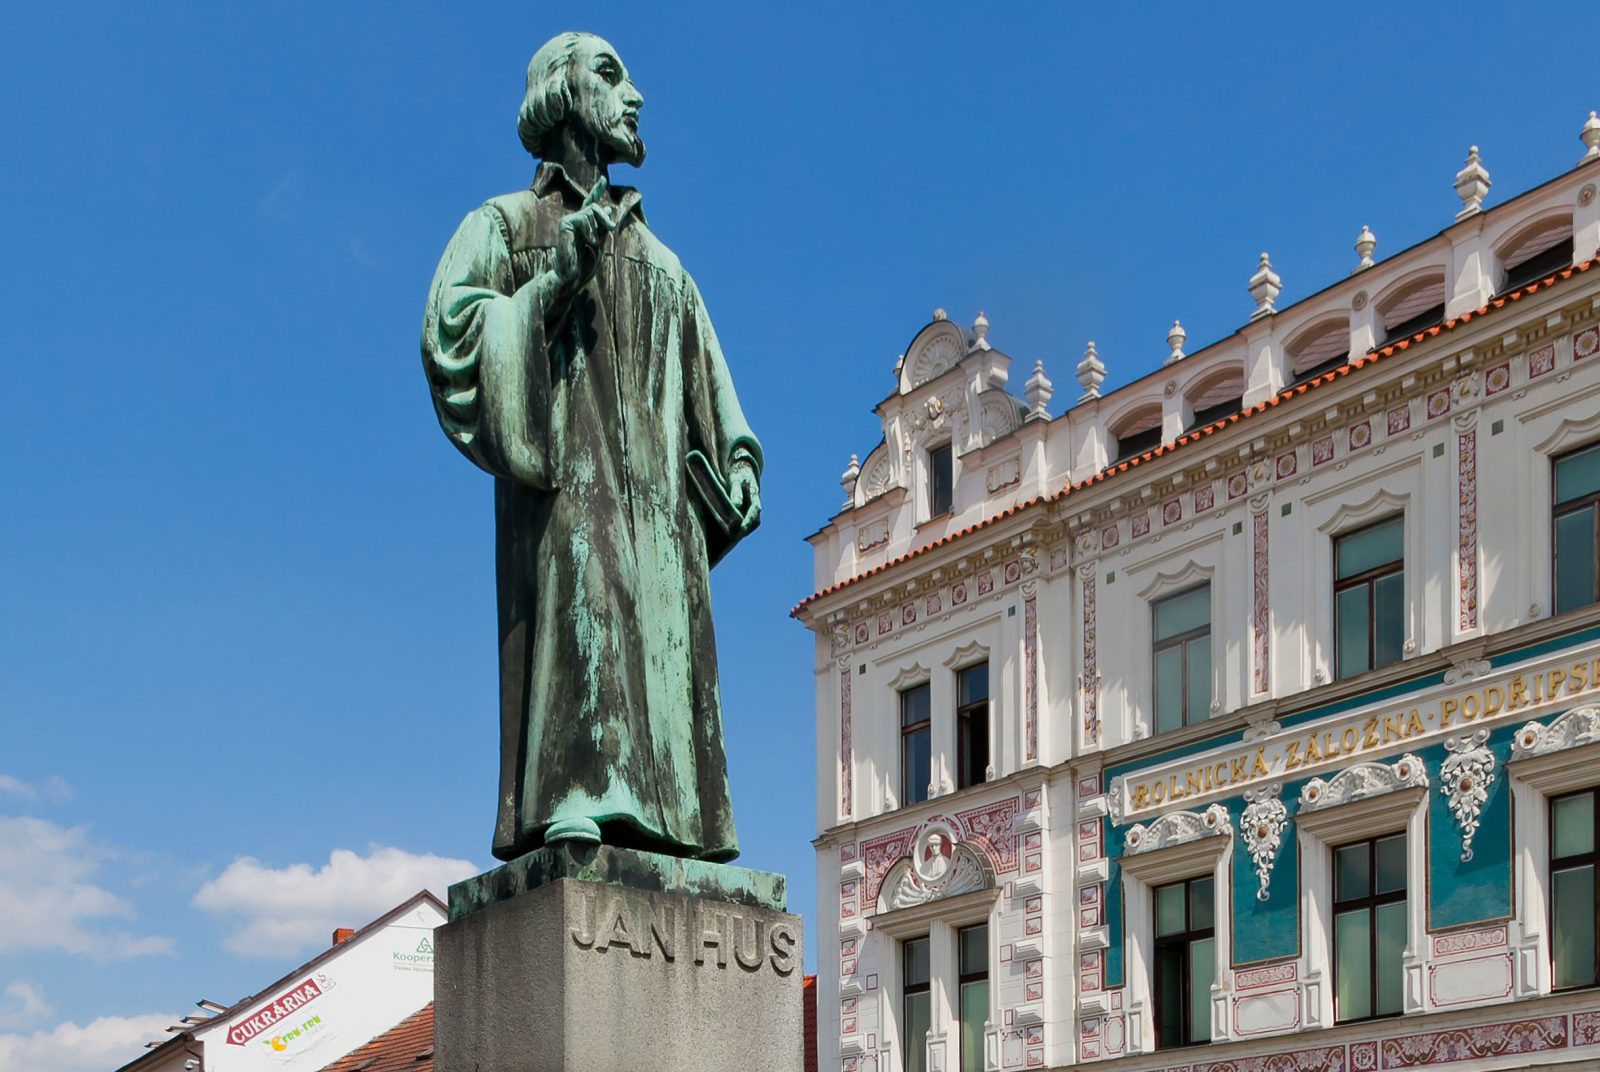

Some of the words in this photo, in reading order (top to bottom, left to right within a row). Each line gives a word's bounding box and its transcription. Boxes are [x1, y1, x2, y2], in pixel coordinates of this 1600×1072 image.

[1133, 747, 1268, 809] ROLNICKÁ
[1285, 708, 1425, 769] ZÁLOŽNA
[392, 952, 434, 963] Kooper
[569, 893, 676, 964] JAN
[693, 902, 796, 978] HUS
[231, 984, 320, 1044] CUKRÁRNA
